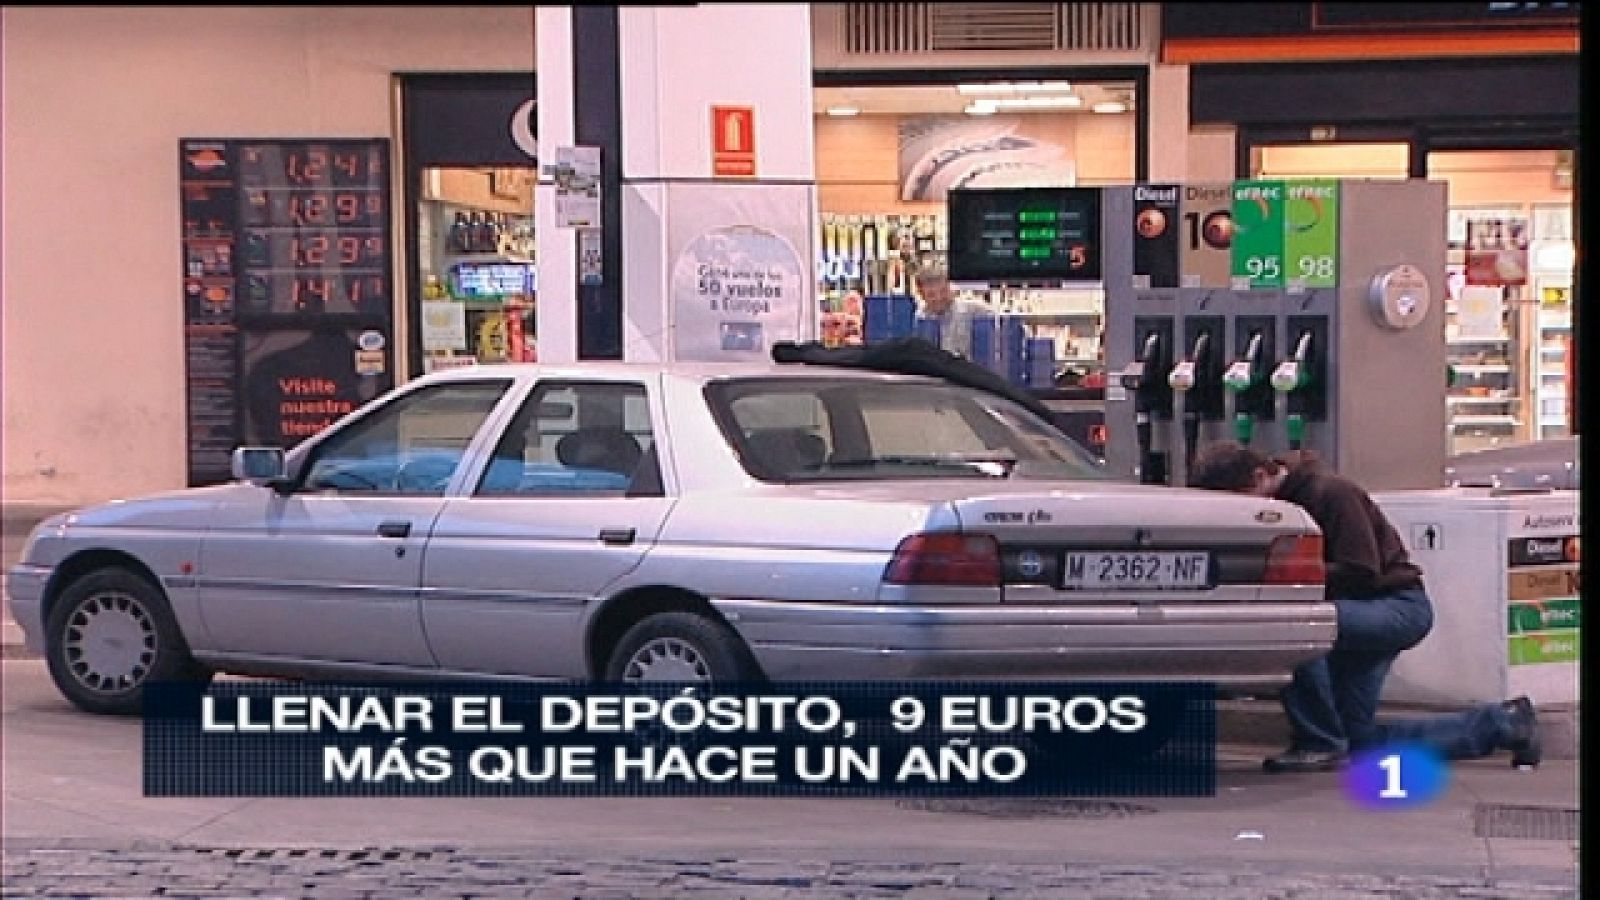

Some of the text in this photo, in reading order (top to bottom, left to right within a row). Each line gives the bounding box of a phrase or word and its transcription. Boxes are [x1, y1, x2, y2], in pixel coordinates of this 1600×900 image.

[1134, 186, 1177, 201] Diesel
[1186, 186, 1231, 201] Diesel
[1245, 255, 1281, 279] 95
[1298, 255, 1334, 279] 98
[698, 278, 782, 298] 50 vuelos
[722, 296, 771, 316] Europa
[279, 377, 336, 395] Visite
[279, 399, 352, 414] nuestra
